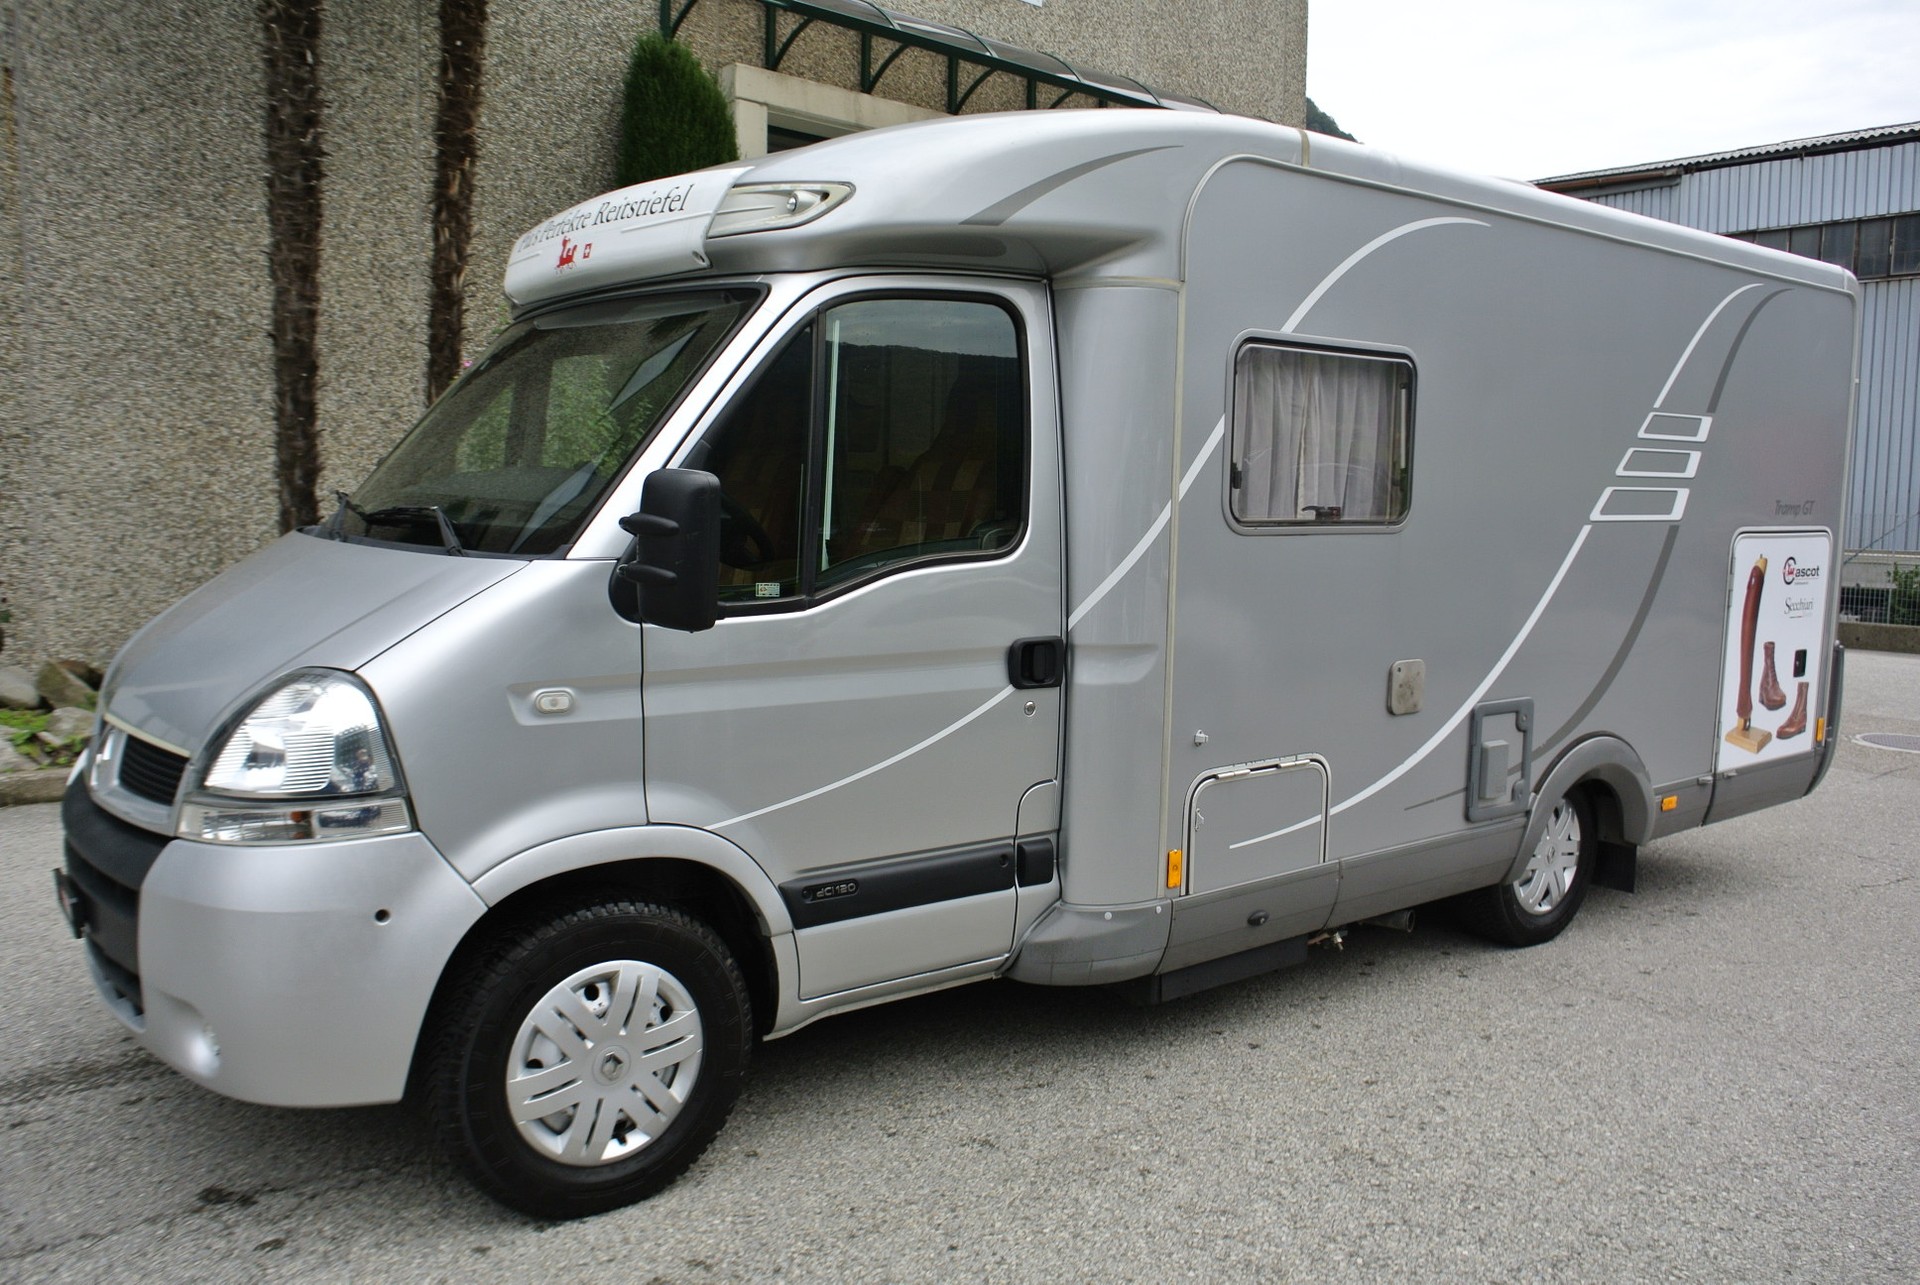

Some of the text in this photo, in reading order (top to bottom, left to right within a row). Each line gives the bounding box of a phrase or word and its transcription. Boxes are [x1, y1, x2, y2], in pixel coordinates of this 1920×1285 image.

[592, 183, 694, 226] Reitstiefel
[1775, 499, 1816, 517] Tramp GT
